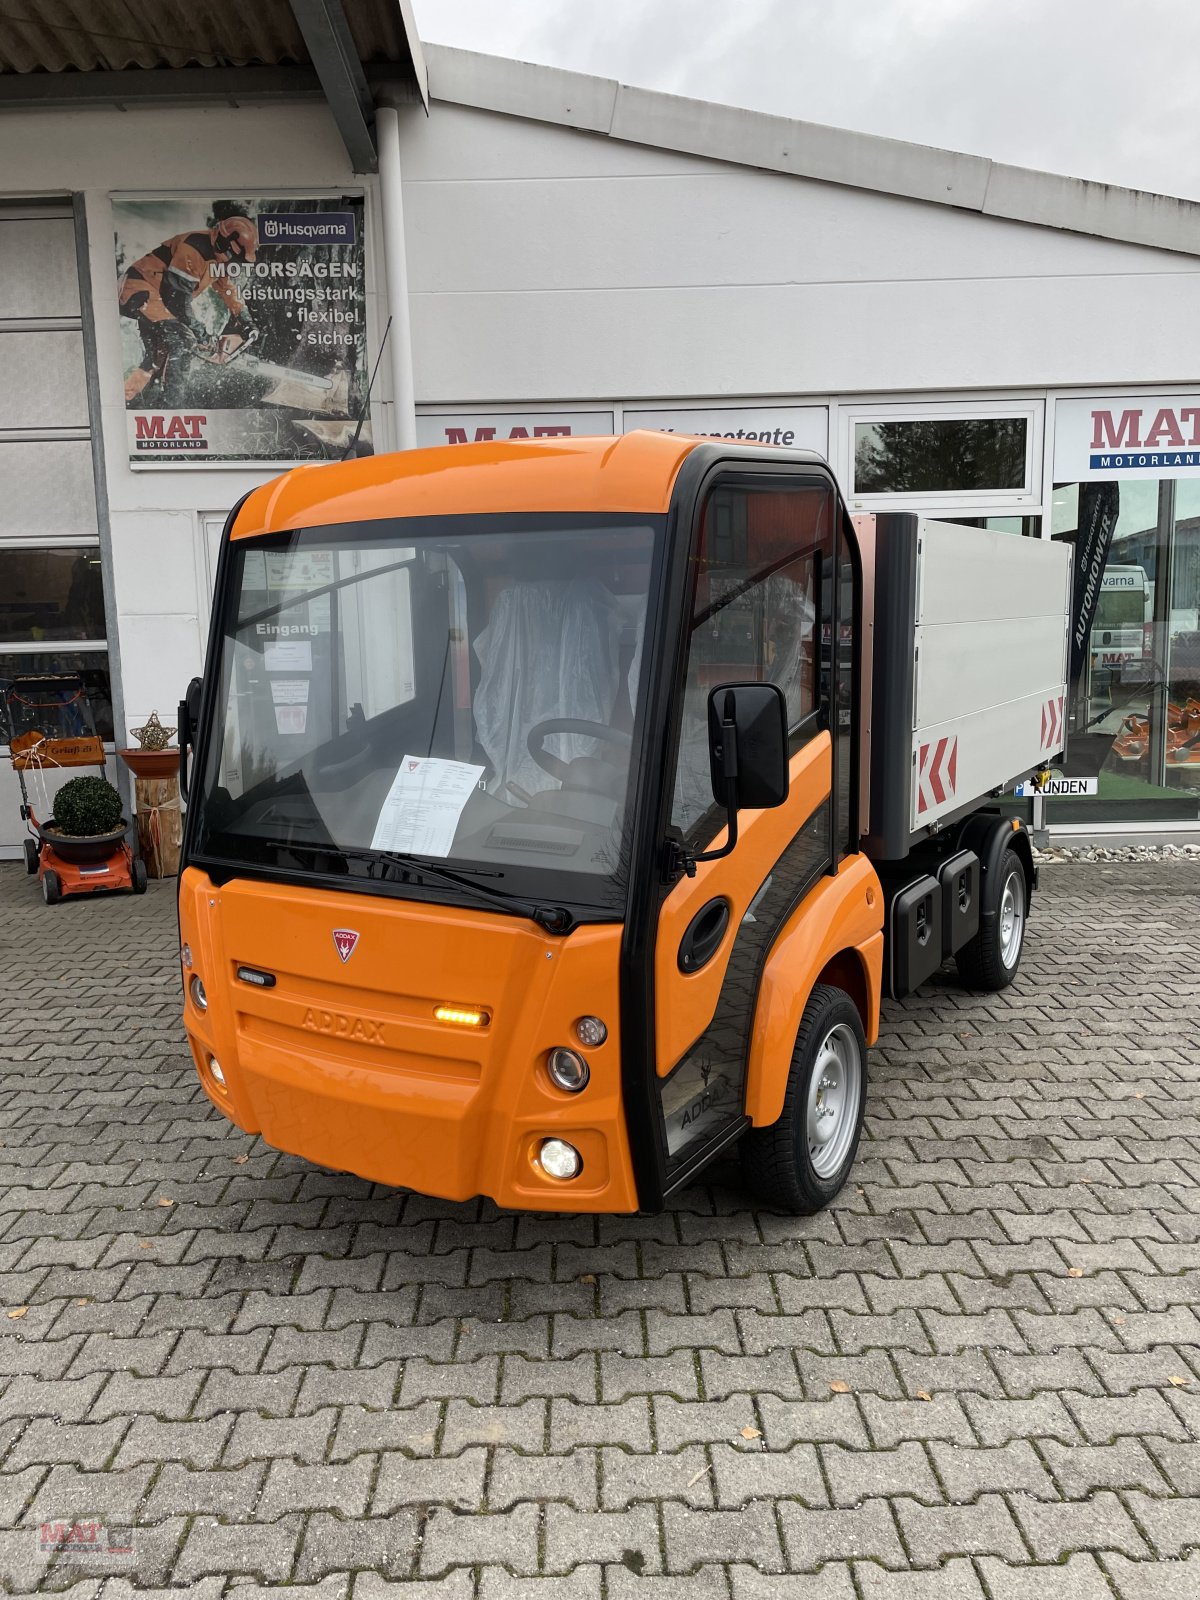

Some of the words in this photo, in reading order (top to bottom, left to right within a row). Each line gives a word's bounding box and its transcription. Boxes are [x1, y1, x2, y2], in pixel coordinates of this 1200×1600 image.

[279, 222, 347, 238] Husqvarna
[209, 259, 358, 278] MOTORSÄGEN
[236, 286, 358, 303] leistungsstark
[297, 308, 359, 323] flexibel
[307, 333, 361, 345] sicher
[134, 415, 207, 439] MAT
[141, 440, 201, 448] MOTORLAND
[1101, 454, 1200, 467] MOTORLAN
[1074, 514, 1112, 649] AUTOMOWER
[1102, 577, 1135, 586] varna
[256, 623, 319, 636] Eingang
[1102, 652, 1135, 664] MAT
[335, 932, 356, 940] ADDAX
[301, 1008, 387, 1045] ADDAX
